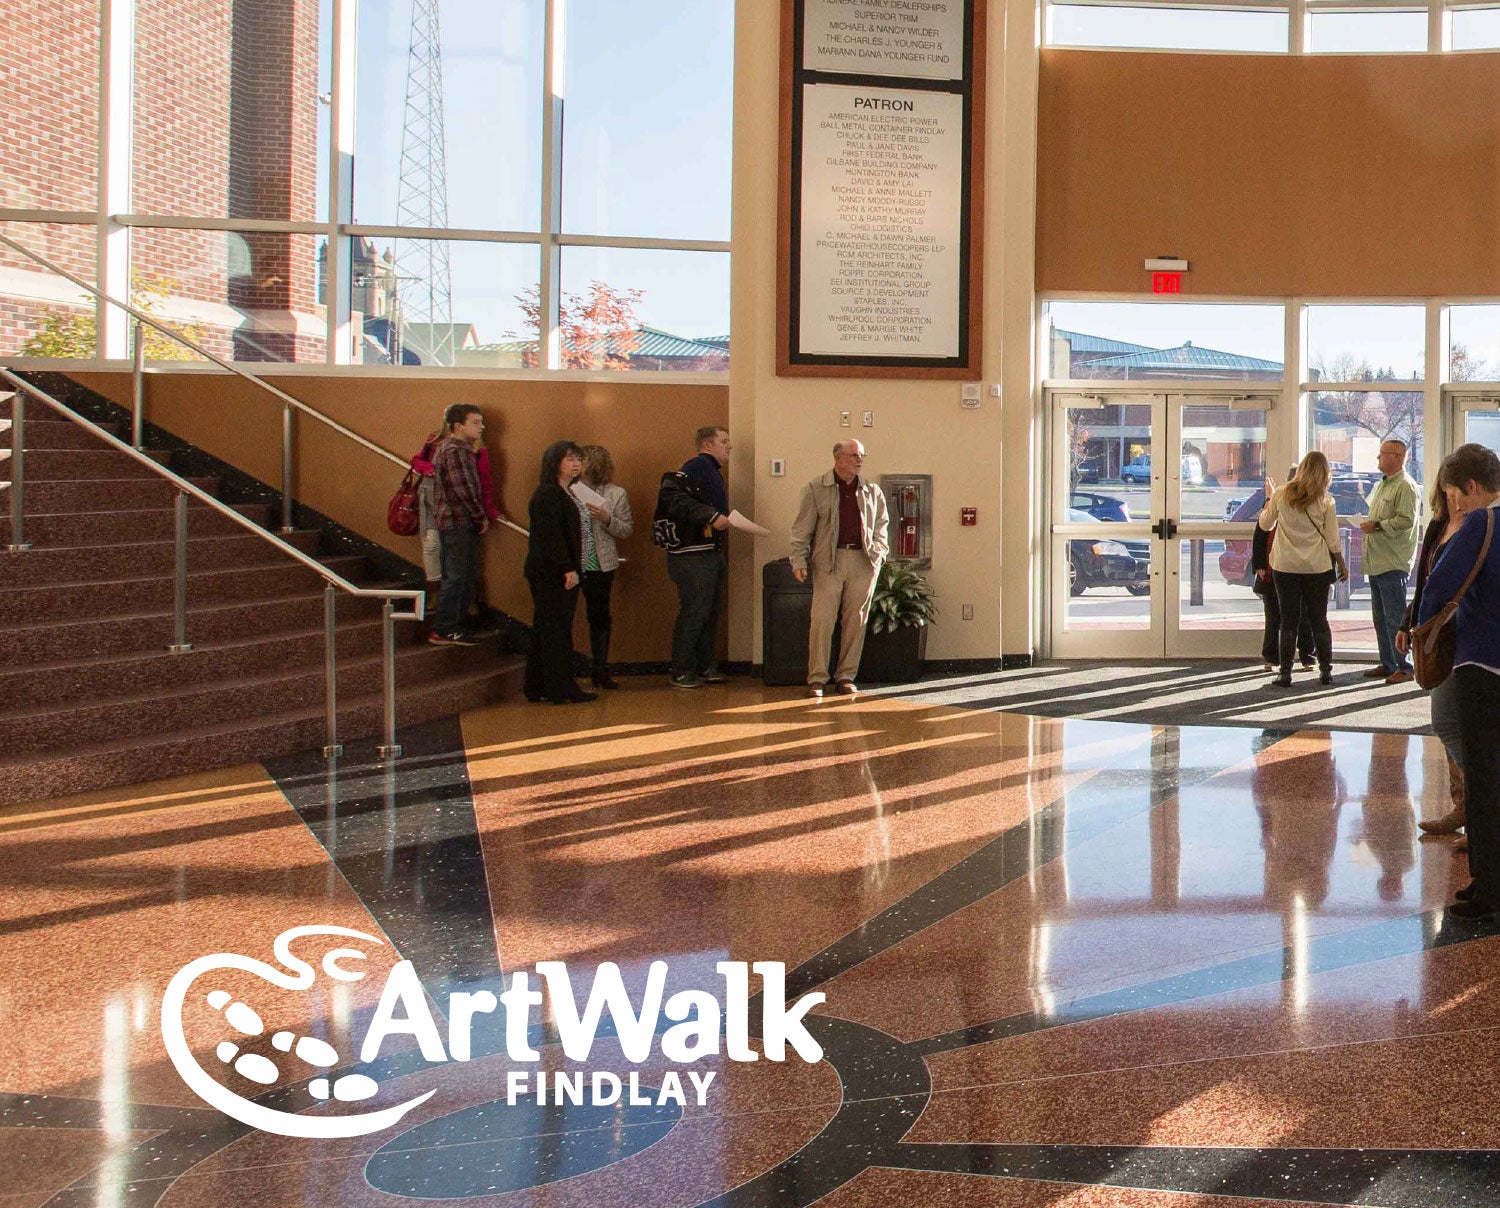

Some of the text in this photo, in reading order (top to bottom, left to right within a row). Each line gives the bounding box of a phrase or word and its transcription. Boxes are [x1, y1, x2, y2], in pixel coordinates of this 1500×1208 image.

[890, 0, 946, 12] DEALERSHIPS
[854, 10, 918, 23] SUPERIOR TRIM
[829, 22, 939, 37] MICHAEL & NANCY WILDER
[826, 34, 841, 43] THE
[843, 35, 883, 46] CHARLES
[894, 39, 935, 50] YOUNGER
[937, 42, 942, 50] &
[817, 46, 949, 64] MARIANN DANA YOUNGER FUND
[854, 98, 913, 112] PATRON
[1153, 272, 1183, 294] EXIT
